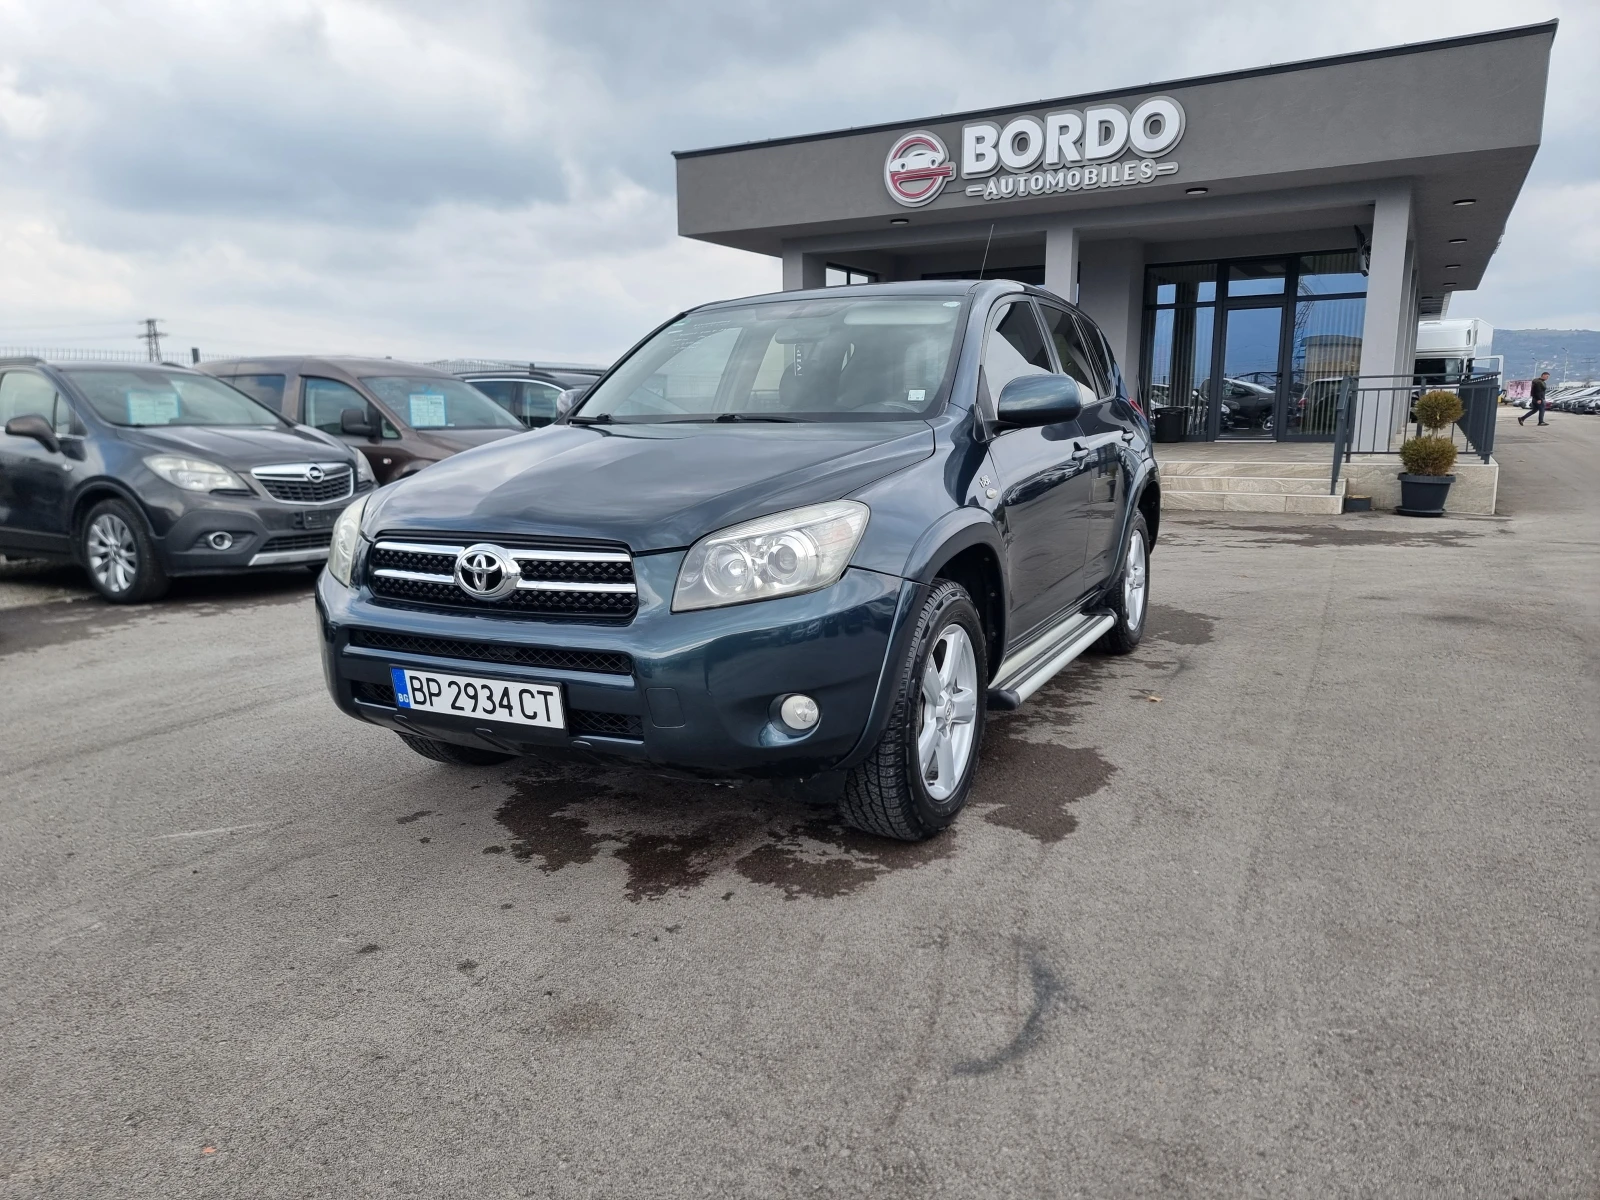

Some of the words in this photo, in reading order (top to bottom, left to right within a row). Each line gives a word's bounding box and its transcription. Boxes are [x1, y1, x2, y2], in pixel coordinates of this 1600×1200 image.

[963, 98, 1182, 175] BORDO
[985, 161, 1154, 198] AUTOMOBILES
[398, 693, 409, 703] BG
[409, 675, 442, 707] BP
[447, 680, 514, 717] 2934
[518, 688, 554, 722] CT
